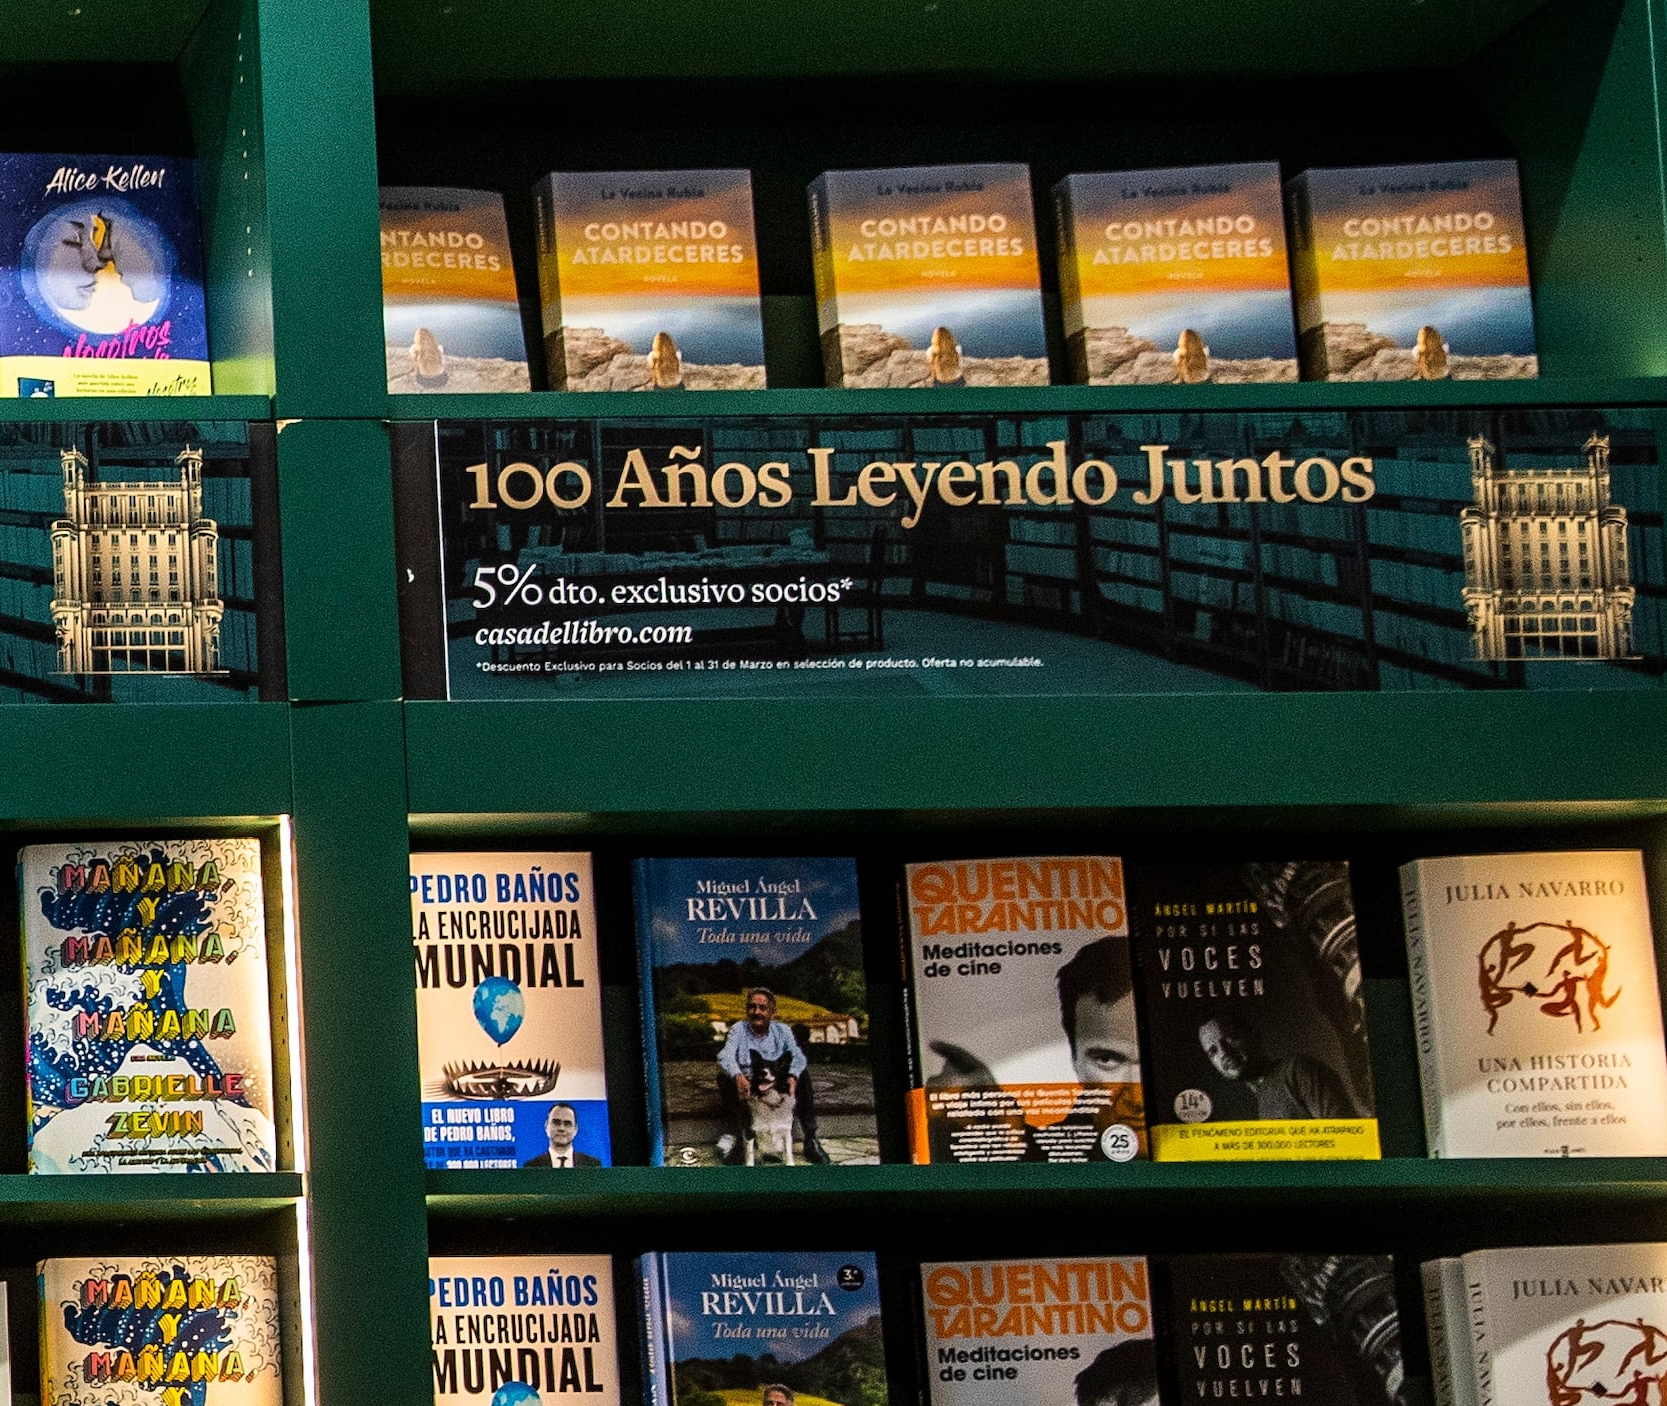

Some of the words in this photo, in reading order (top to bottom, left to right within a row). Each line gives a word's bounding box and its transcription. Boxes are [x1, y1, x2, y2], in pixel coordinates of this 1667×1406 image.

[585, 220, 727, 242] CONTANDO
[571, 242, 744, 266] ATARDECERES
[465, 462, 591, 509] 100
[606, 445, 792, 507] Años
[808, 442, 1117, 528] Leyendo
[1133, 445, 1375, 505] Juntos
[473, 563, 543, 609] 5%
[549, 577, 606, 605] dto.
[611, 576, 744, 604] exclusivo
[475, 621, 693, 645] casadellibro.com
[696, 880, 750, 897] Miguel
[755, 876, 800, 897] Ángel
[910, 860, 1124, 902] QUENTIN
[1445, 882, 1510, 904] JULIA
[1518, 879, 1626, 900] NAVARRO
[687, 898, 818, 921] REVILLA
[912, 893, 1126, 937] TARANTINO
[922, 941, 1062, 960] Meditaciones
[924, 960, 950, 978] de
[957, 959, 1001, 977] cine
